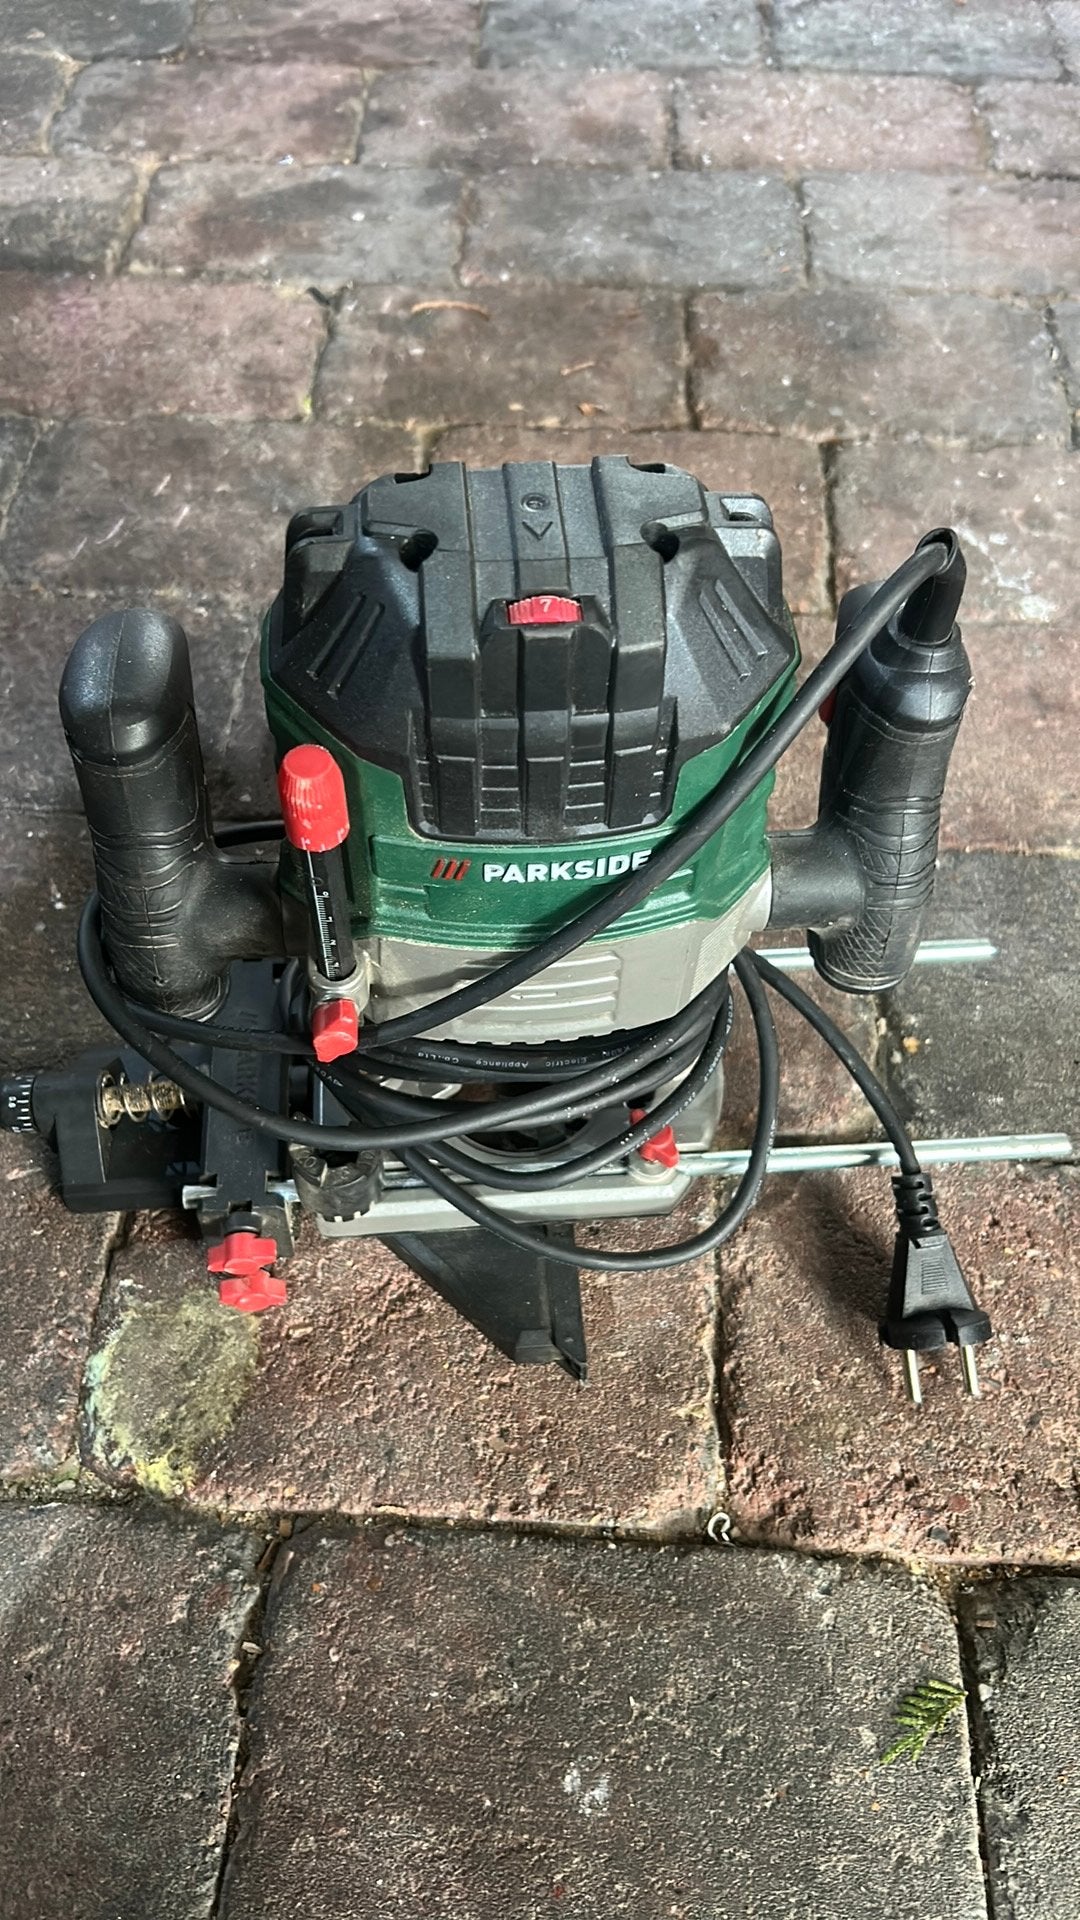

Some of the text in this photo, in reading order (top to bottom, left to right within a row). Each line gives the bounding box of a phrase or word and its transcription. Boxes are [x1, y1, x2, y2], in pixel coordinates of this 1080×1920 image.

[539, 598, 552, 612] 7
[483, 850, 651, 882] PARKSIDE
[475, 1059, 529, 1068] Appliance
